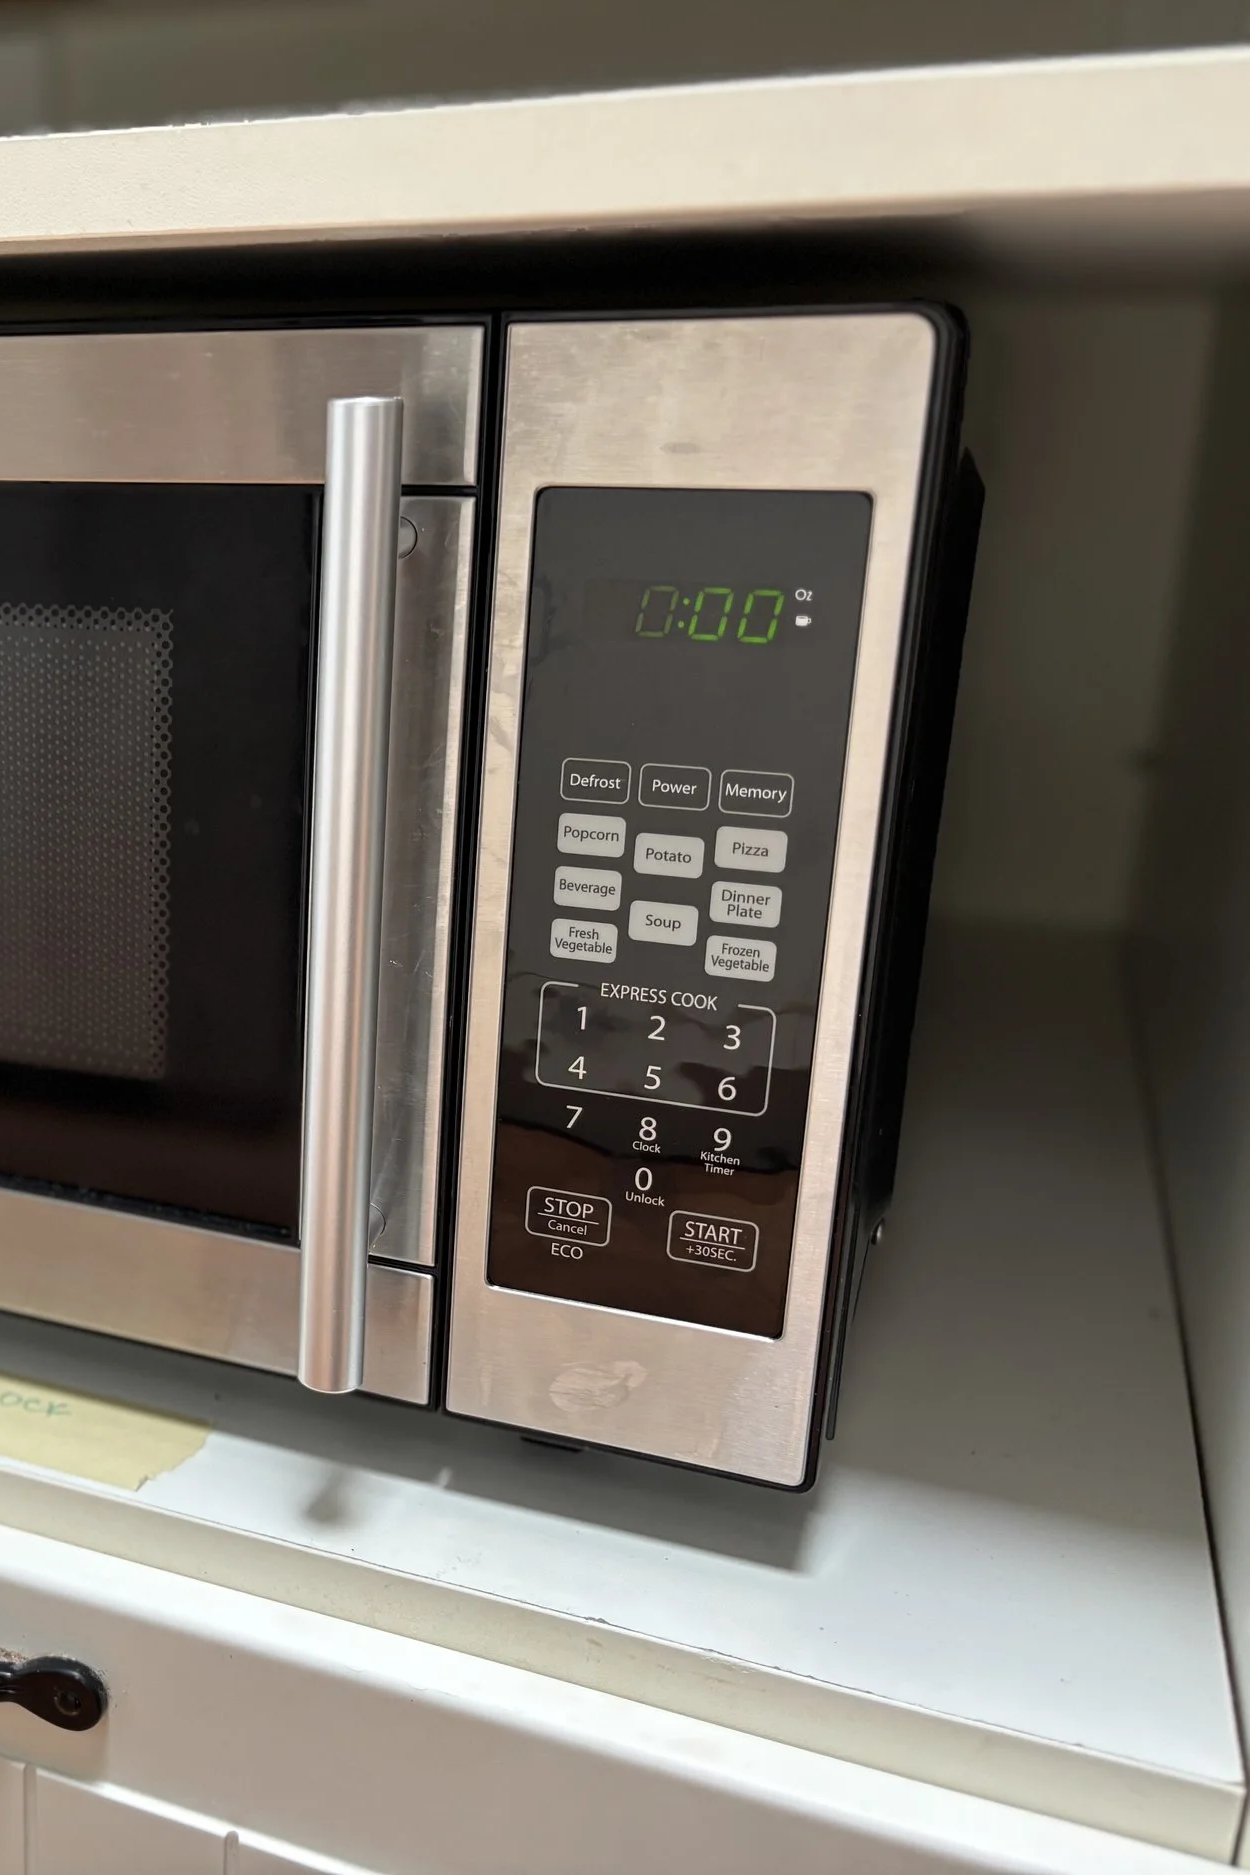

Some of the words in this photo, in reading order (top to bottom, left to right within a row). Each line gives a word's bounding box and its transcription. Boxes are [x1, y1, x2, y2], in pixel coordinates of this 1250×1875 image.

[635, 585, 784, 643] 0:00
[569, 773, 621, 790] Defrost
[652, 779, 697, 795] Power
[725, 783, 787, 803] Memory
[563, 826, 619, 845] Popcorn
[646, 848, 692, 864] Potato
[732, 842, 769, 858] Pizza
[559, 879, 616, 897] Beverage
[721, 890, 771, 907] Dinner
[727, 904, 762, 920] Plate
[645, 914, 682, 931] Soup
[569, 926, 599, 941] Fresh
[554, 938, 613, 956] Vegetable
[721, 943, 760, 958] Frozen
[711, 954, 770, 973] Vegetable
[600, 983, 667, 1004] EXPRESS
[671, 991, 718, 1010] COOK
[576, 1006, 587, 1030] 1
[648, 1015, 665, 1041] 2
[723, 1025, 741, 1050] 3
[568, 1056, 587, 1079] 4
[644, 1065, 661, 1090] 5
[718, 1077, 737, 1101] 6
[566, 1105, 583, 1129] 7
[639, 1117, 657, 1141] 8
[632, 1141, 661, 1154] Clock
[713, 1128, 732, 1151] 9
[700, 1151, 740, 1166] Kitchen
[704, 1163, 734, 1176] Timer
[634, 1167, 652, 1191] 0
[544, 1197, 594, 1219] STOP
[625, 1191, 665, 1207] Unlock
[548, 1219, 588, 1236] Cancel
[684, 1221, 742, 1245] START
[551, 1243, 583, 1259] ECO
[686, 1245, 737, 1262] +30SEC.
